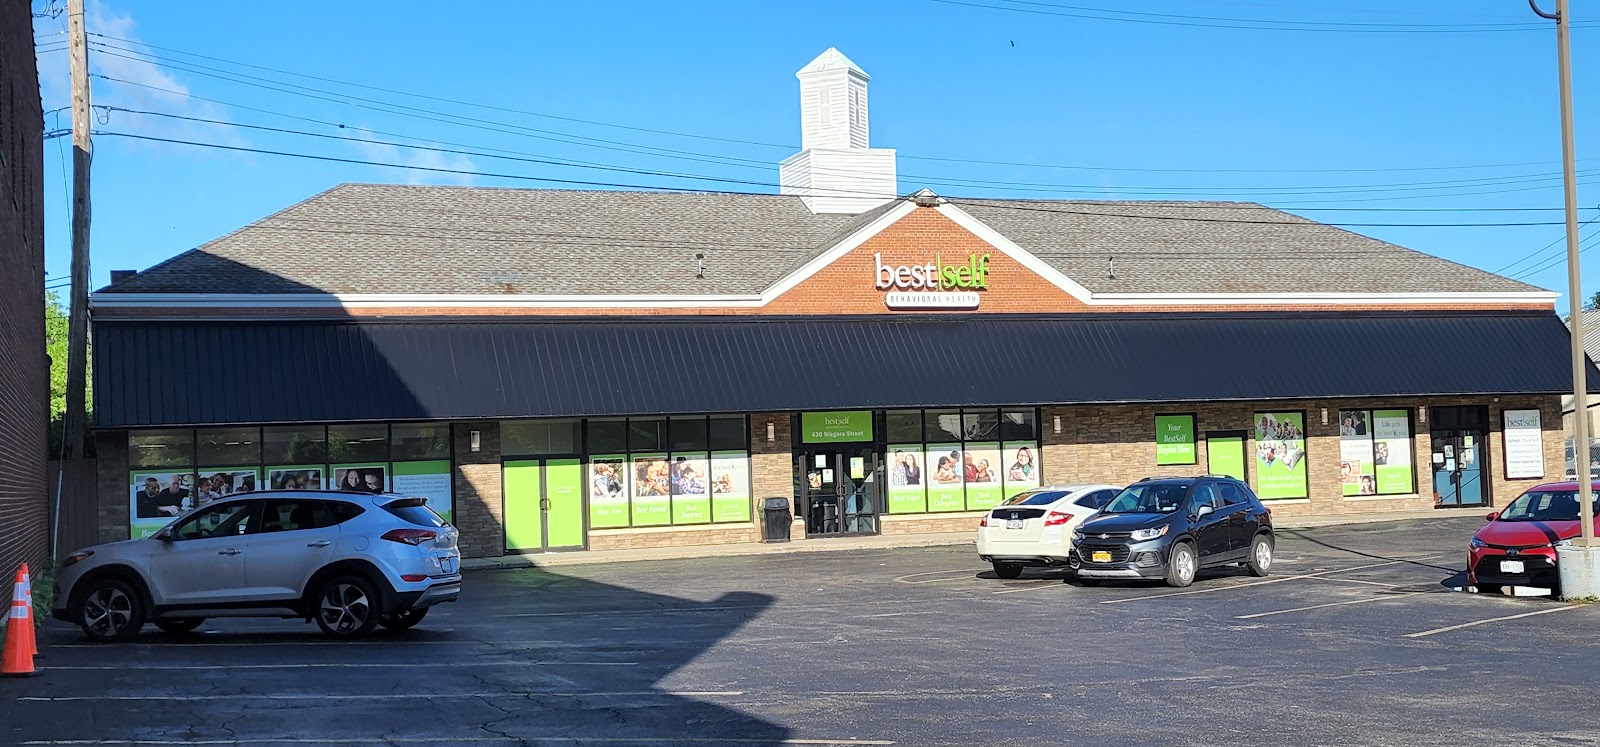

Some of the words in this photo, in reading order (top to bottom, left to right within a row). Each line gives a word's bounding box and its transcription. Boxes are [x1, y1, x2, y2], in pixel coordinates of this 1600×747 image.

[890, 295, 942, 303] BEHAVIORAL
[945, 295, 977, 303] HEALTH
[1167, 423, 1182, 432] Your
[1163, 433, 1187, 444] BestSelf
